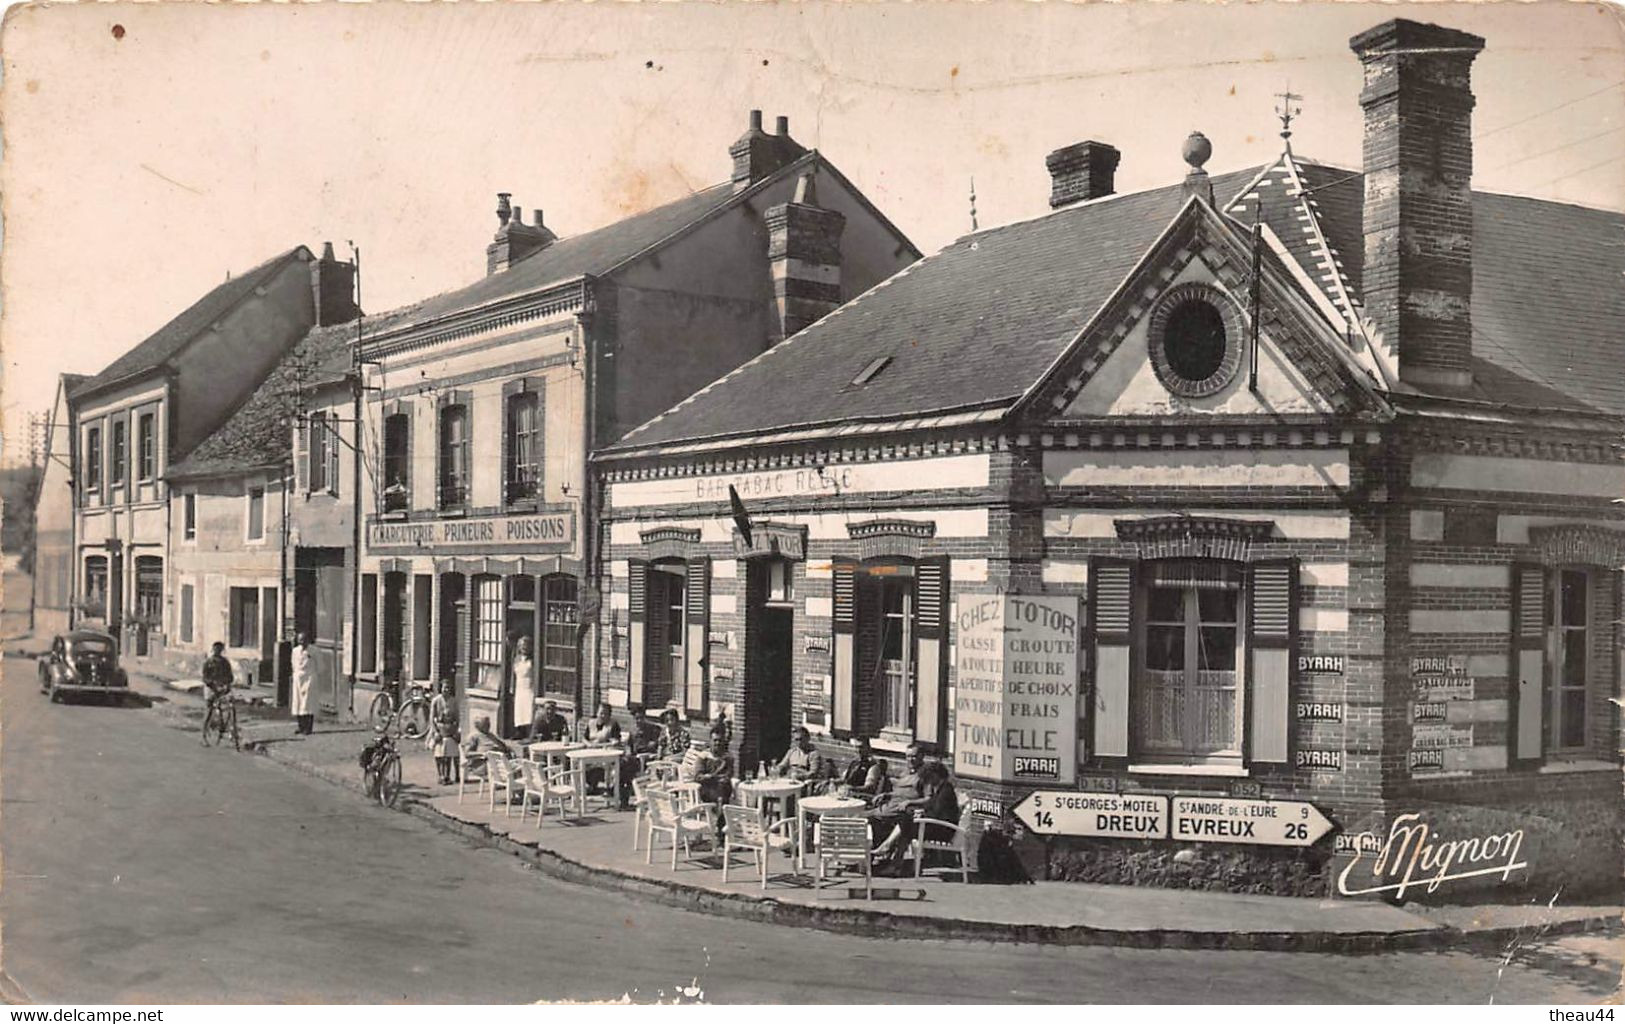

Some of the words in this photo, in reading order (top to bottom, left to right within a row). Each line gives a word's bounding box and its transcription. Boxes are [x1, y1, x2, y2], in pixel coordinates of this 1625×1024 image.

[734, 473, 784, 495] TABAC
[444, 522, 494, 542] PRIMEURS
[507, 518, 565, 540] POISSONS
[961, 600, 1000, 632] CHEZ
[1011, 599, 1076, 639] TOTOR
[1010, 639, 1075, 654] CROUTE
[1013, 660, 1065, 676] HEURE
[1299, 657, 1343, 671] BYRRH
[1413, 658, 1445, 672] BYRRH
[1028, 682, 1073, 697] CHOIX
[1011, 702, 1060, 718] FRAIS
[1297, 704, 1341, 719] BYRRH
[1415, 703, 1446, 719] BYRRH
[1015, 758, 1058, 774] BYRRH
[1296, 752, 1341, 766] BYRRH
[1411, 751, 1442, 767] BYRRH
[972, 799, 1000, 816] BYRRH
[1034, 795, 1042, 807] 5
[1301, 807, 1309, 819] 9
[1034, 811, 1053, 828] 14
[1097, 814, 1160, 833] DREUX
[1179, 817, 1255, 837] EVREUX
[1284, 822, 1308, 840] 26
